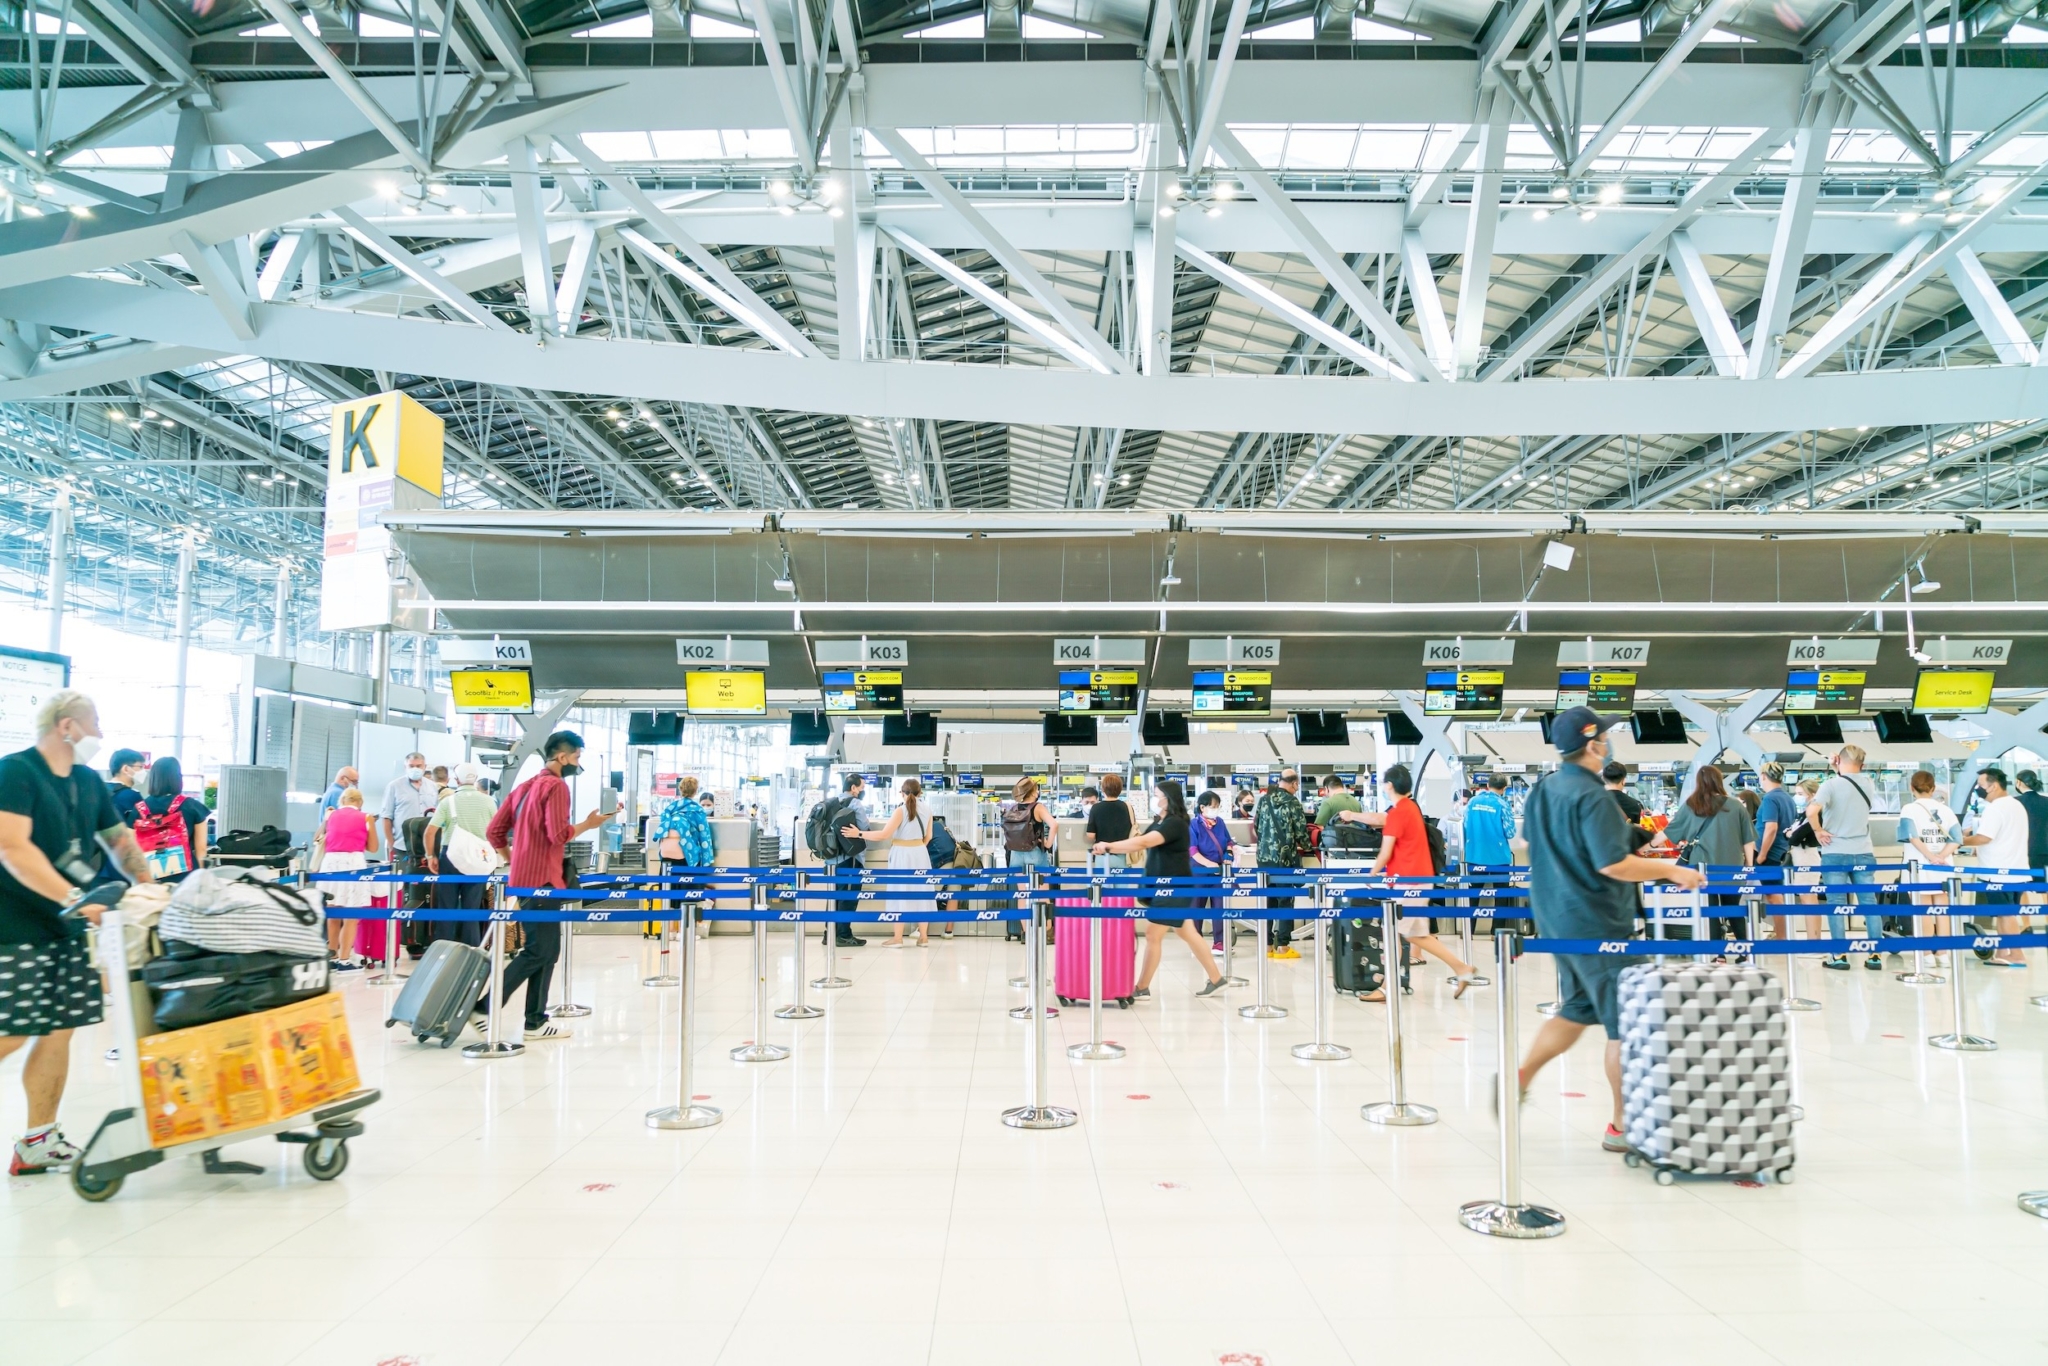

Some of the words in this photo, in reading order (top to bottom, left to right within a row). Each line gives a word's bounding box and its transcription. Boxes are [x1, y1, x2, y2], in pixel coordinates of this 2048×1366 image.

[341, 404, 380, 473] K
[496, 646, 524, 658] K01
[683, 646, 714, 658] K02
[871, 647, 900, 658] K03
[1061, 646, 1091, 658] K04
[1243, 646, 1273, 658] K05
[1430, 647, 1460, 658] K06
[1612, 648, 1642, 659] K07
[1795, 646, 1825, 658] K08
[1973, 646, 2003, 658] K09
[3, 661, 27, 672] NOTICE
[857, 892, 875, 900] AOT
[489, 910, 512, 920] AOT
[1125, 909, 1145, 917] AOT
[1319, 909, 1342, 919] AOT
[1473, 909, 1496, 917] AOT
[1666, 908, 1689, 916] AOT
[1834, 906, 1856, 914] AOT
[2019, 906, 2041, 914] AOT
[587, 913, 611, 922] AOT
[779, 912, 803, 920] AOT
[878, 913, 901, 921] AOT
[977, 911, 1000, 920] AOT
[1849, 941, 1878, 951] AOT
[1973, 937, 2001, 947] AOT
[1599, 942, 1628, 953] AOT
[1725, 942, 1754, 953] AOT
